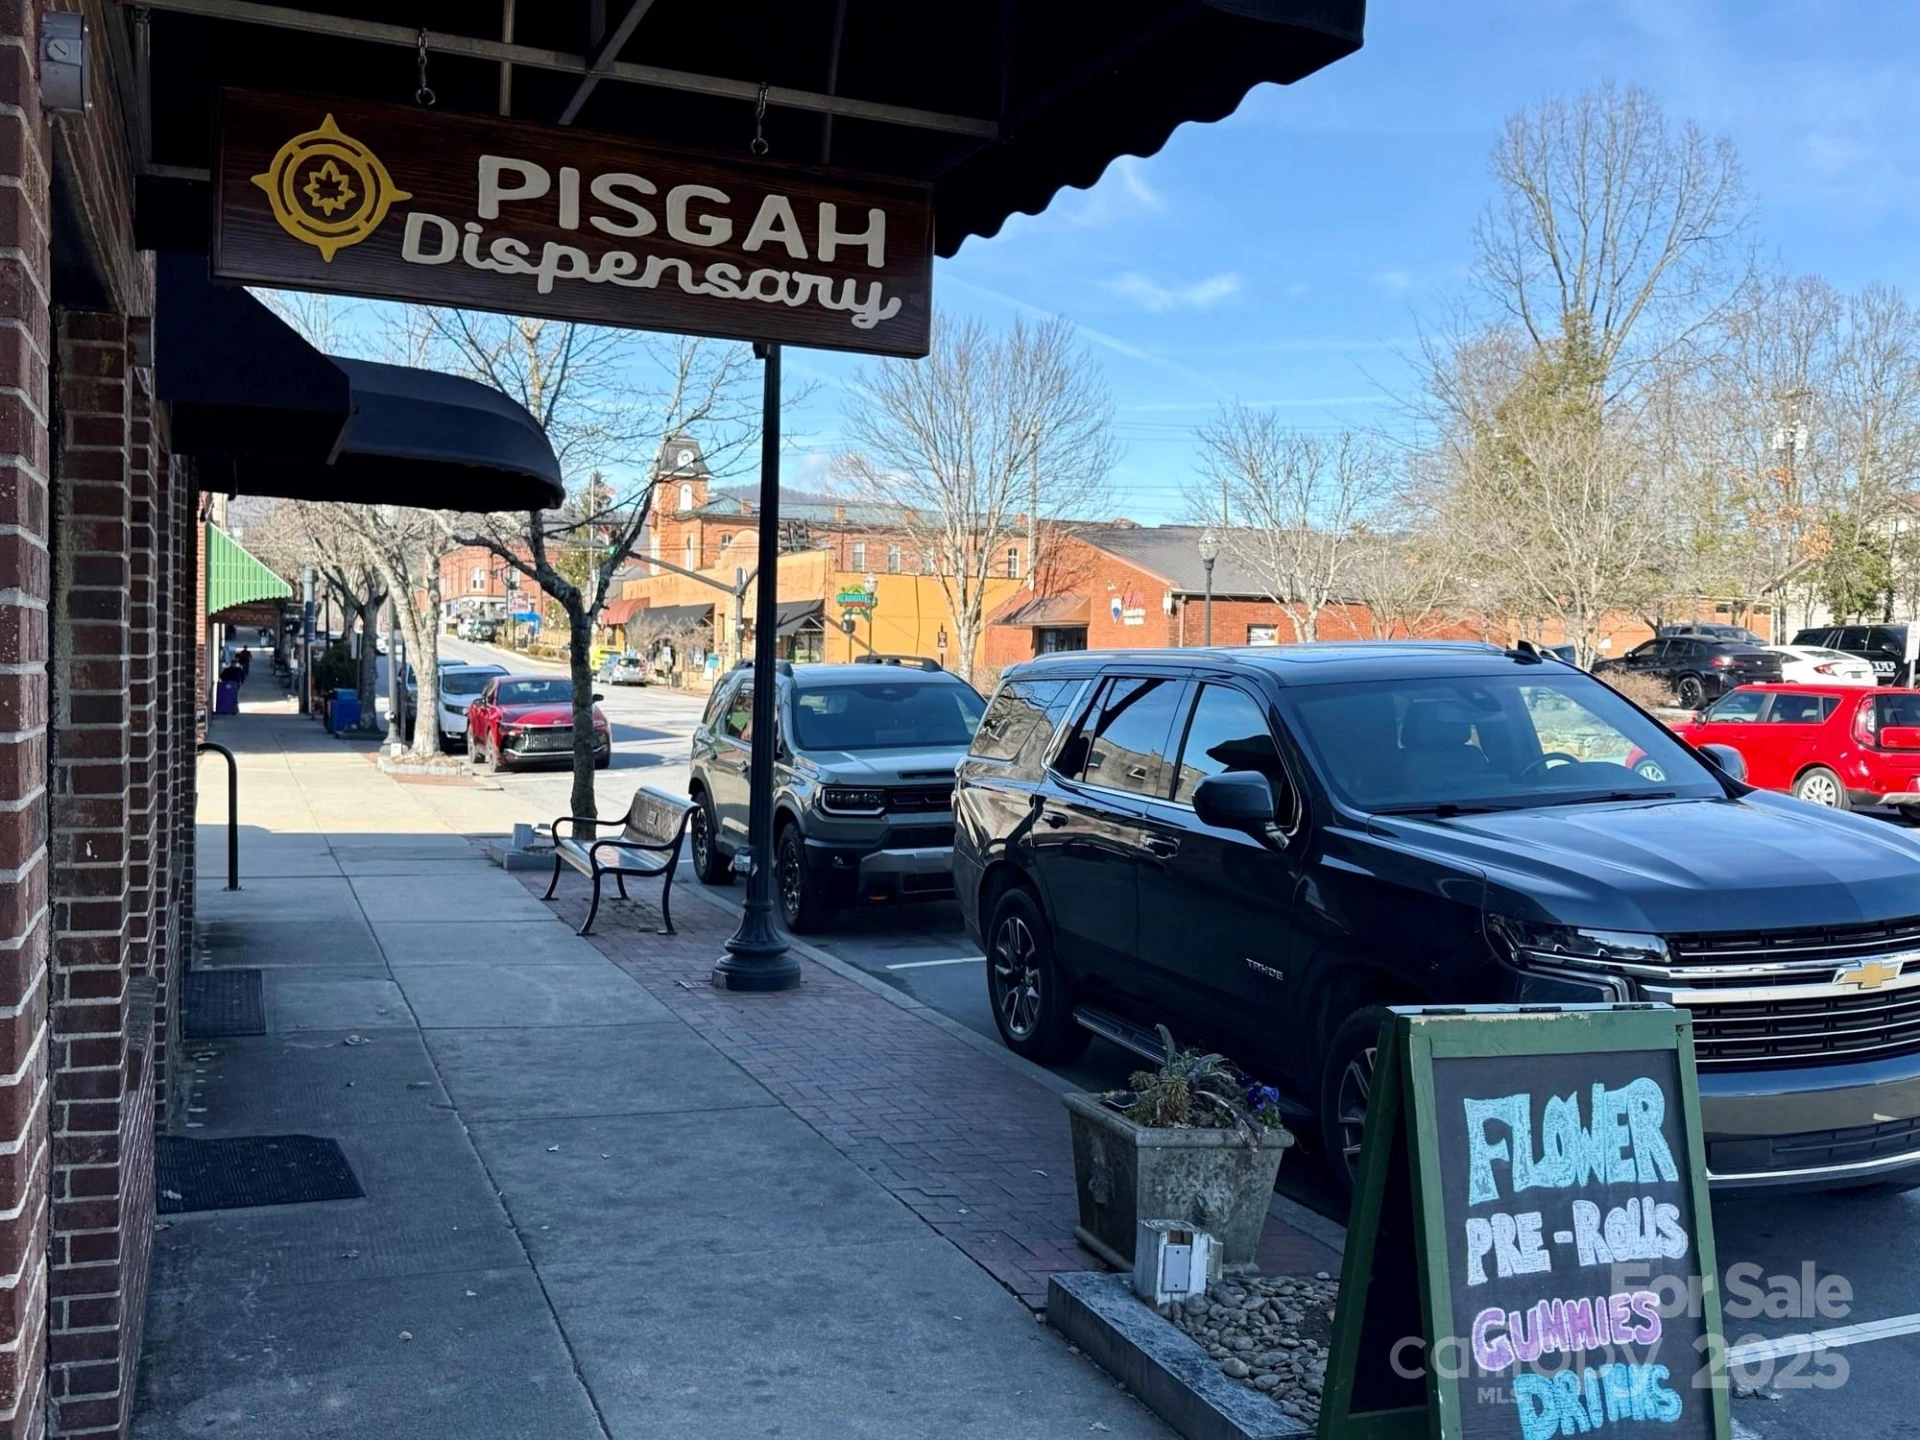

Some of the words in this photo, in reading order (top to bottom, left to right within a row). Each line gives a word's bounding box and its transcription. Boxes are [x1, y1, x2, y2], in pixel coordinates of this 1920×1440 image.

[477, 154, 886, 268] PISGAH
[401, 211, 902, 330] Dispensary
[1245, 957, 1284, 981] TAHOE
[1463, 1076, 1680, 1207] FLOWER
[1471, 1290, 1663, 1372] GUMMIES
[1512, 1362, 1684, 1440] DRINKS
